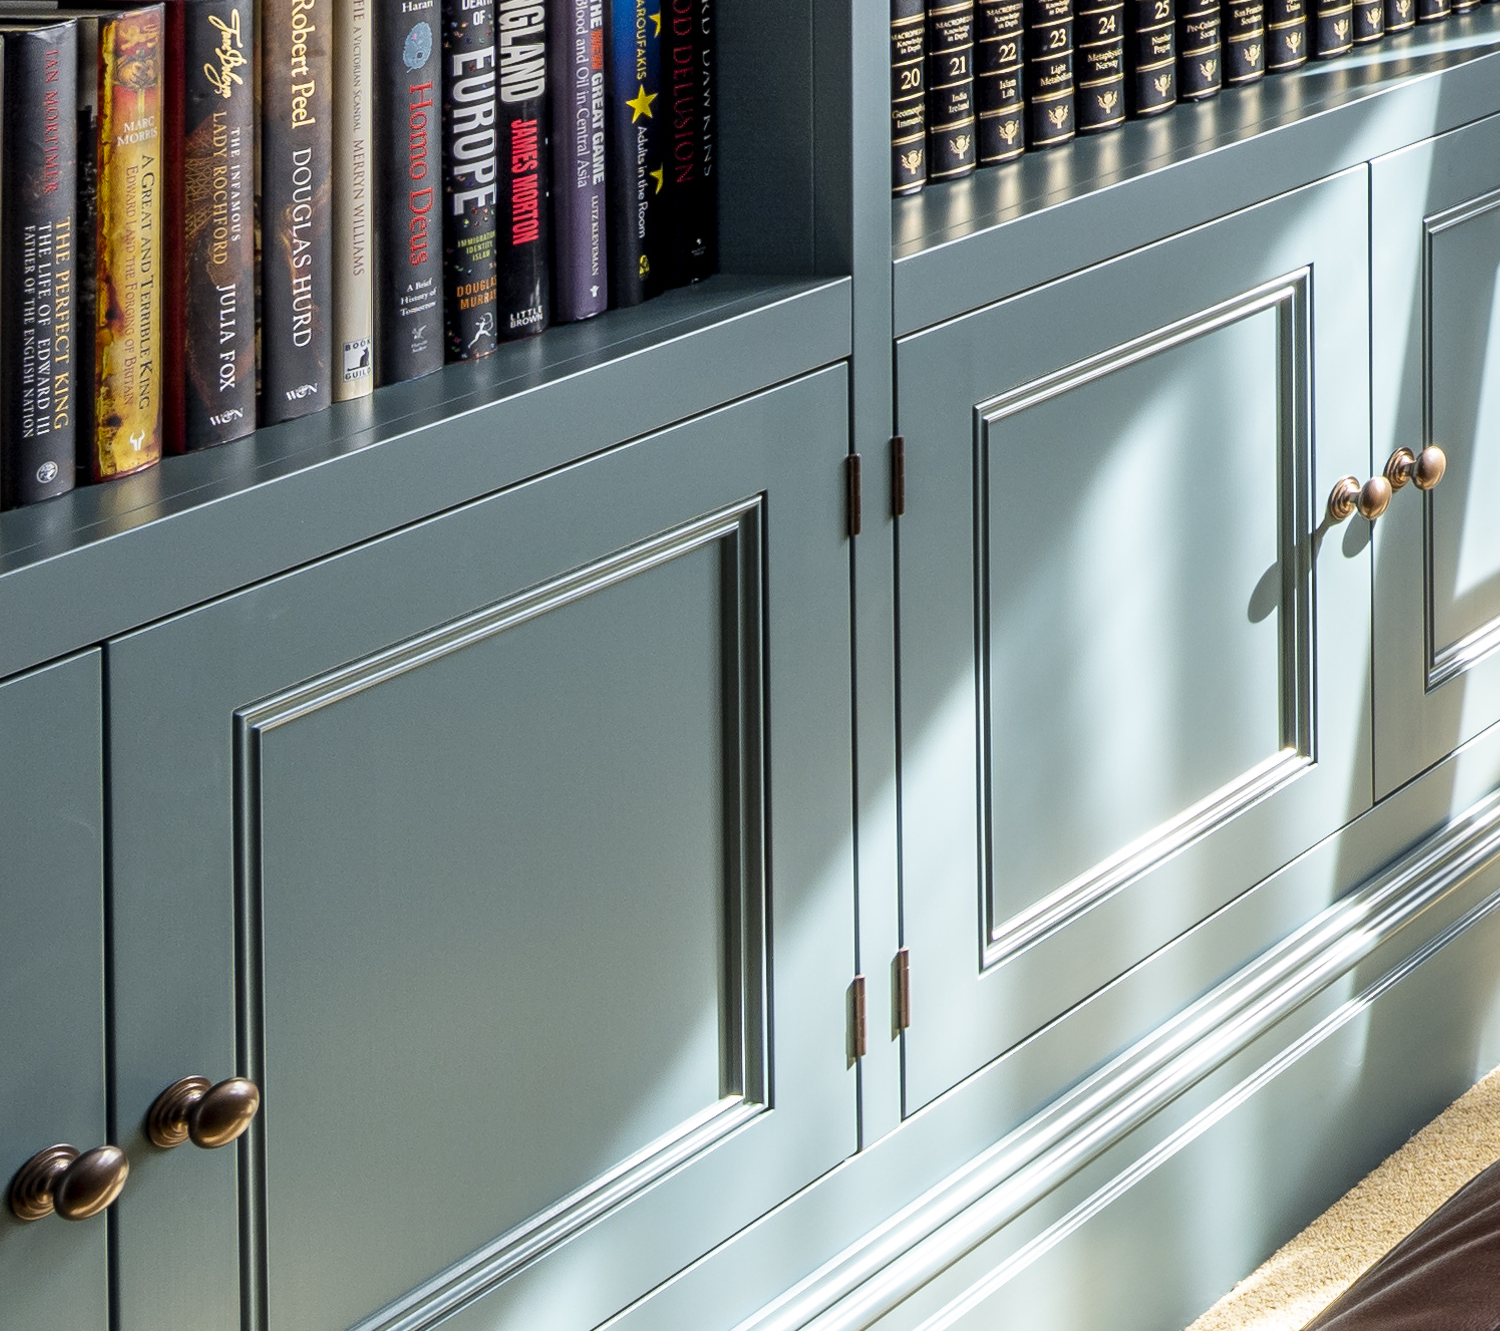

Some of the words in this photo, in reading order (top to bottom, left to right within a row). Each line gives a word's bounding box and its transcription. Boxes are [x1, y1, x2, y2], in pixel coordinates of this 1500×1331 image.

[1049, 27, 1067, 49] 23
[1098, 14, 1116, 36] 24
[290, 81, 315, 128] Peel
[408, 84, 433, 180] Homo
[453, 50, 496, 216] EUROPE
[511, 118, 538, 173] JAMES
[291, 149, 312, 268] DOUGLAS
[409, 188, 433, 266] Deus
[511, 176, 538, 245] MORTON
[292, 275, 312, 347] HURD
